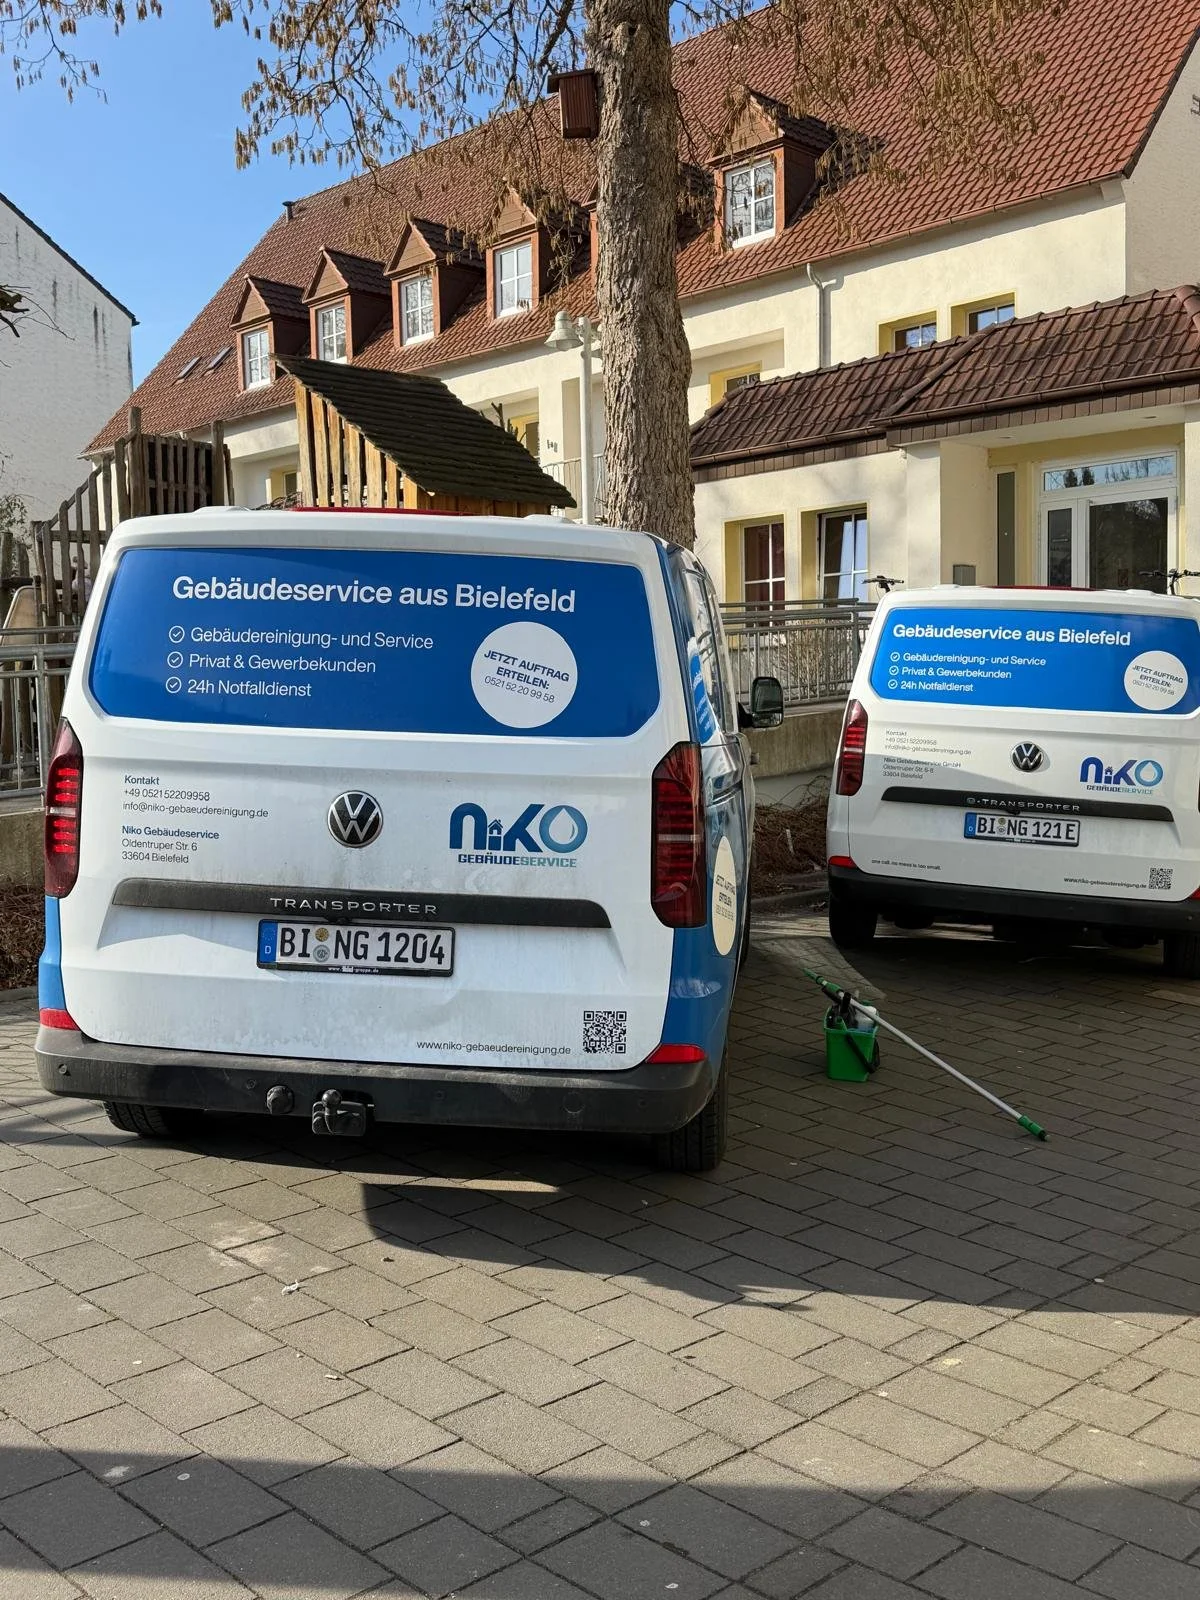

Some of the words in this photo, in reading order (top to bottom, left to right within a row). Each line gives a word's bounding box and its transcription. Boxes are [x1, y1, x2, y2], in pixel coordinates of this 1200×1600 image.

[172, 575, 393, 604] Gebäudeservice
[399, 586, 448, 606] aus
[455, 583, 576, 613] Bielefeld
[190, 626, 338, 648] Gebäudereinigung-
[341, 632, 371, 647] und
[374, 632, 434, 649] Service
[892, 624, 1022, 640] Gebäudeservice
[1026, 630, 1055, 642] aus
[1058, 628, 1131, 646] Bielefeld
[188, 653, 231, 668] Privat
[234, 654, 244, 669] &
[248, 654, 376, 673] Gewerbekunden
[484, 650, 518, 666] JETZT
[518, 660, 570, 682] AUFTRAG
[990, 656, 1009, 664] und
[1010, 655, 1046, 666] Service
[902, 667, 926, 676] Privat
[928, 668, 935, 676] &
[936, 668, 1012, 679] Gewerbekunden
[1132, 665, 1152, 674] JETZT
[496, 666, 550, 690] ERTEILEN:
[900, 680, 917, 690] 24h
[918, 681, 974, 692] Notfalldienst
[187, 679, 215, 694] 24h
[218, 680, 312, 697] Notfalldienst
[484, 675, 504, 688] 0521
[517, 684, 529, 696] 20
[530, 688, 542, 700] 99
[542, 692, 555, 704] 58
[124, 774, 160, 786] Kontakt
[124, 788, 140, 798] +49
[122, 802, 269, 818] info@niko-gebaeudereinigung.de
[122, 825, 142, 835] Niko
[144, 826, 220, 840] Gebäudeservice
[976, 816, 996, 834] BI
[1006, 818, 1028, 836] NG
[122, 838, 174, 852] Oldentruper
[175, 840, 190, 850] Str.
[191, 842, 198, 851] 6
[122, 850, 150, 861] 33604
[152, 852, 189, 864] Bielefeld
[458, 852, 577, 868] GEBÄUDESERVICE
[270, 897, 438, 914] TRANSPORTER
[264, 945, 272, 954] D
[280, 927, 311, 958] BI
[334, 930, 370, 960] NG
[376, 932, 445, 965] 1204
[416, 1041, 571, 1056] www.niko-gebaeudereinigung.de
